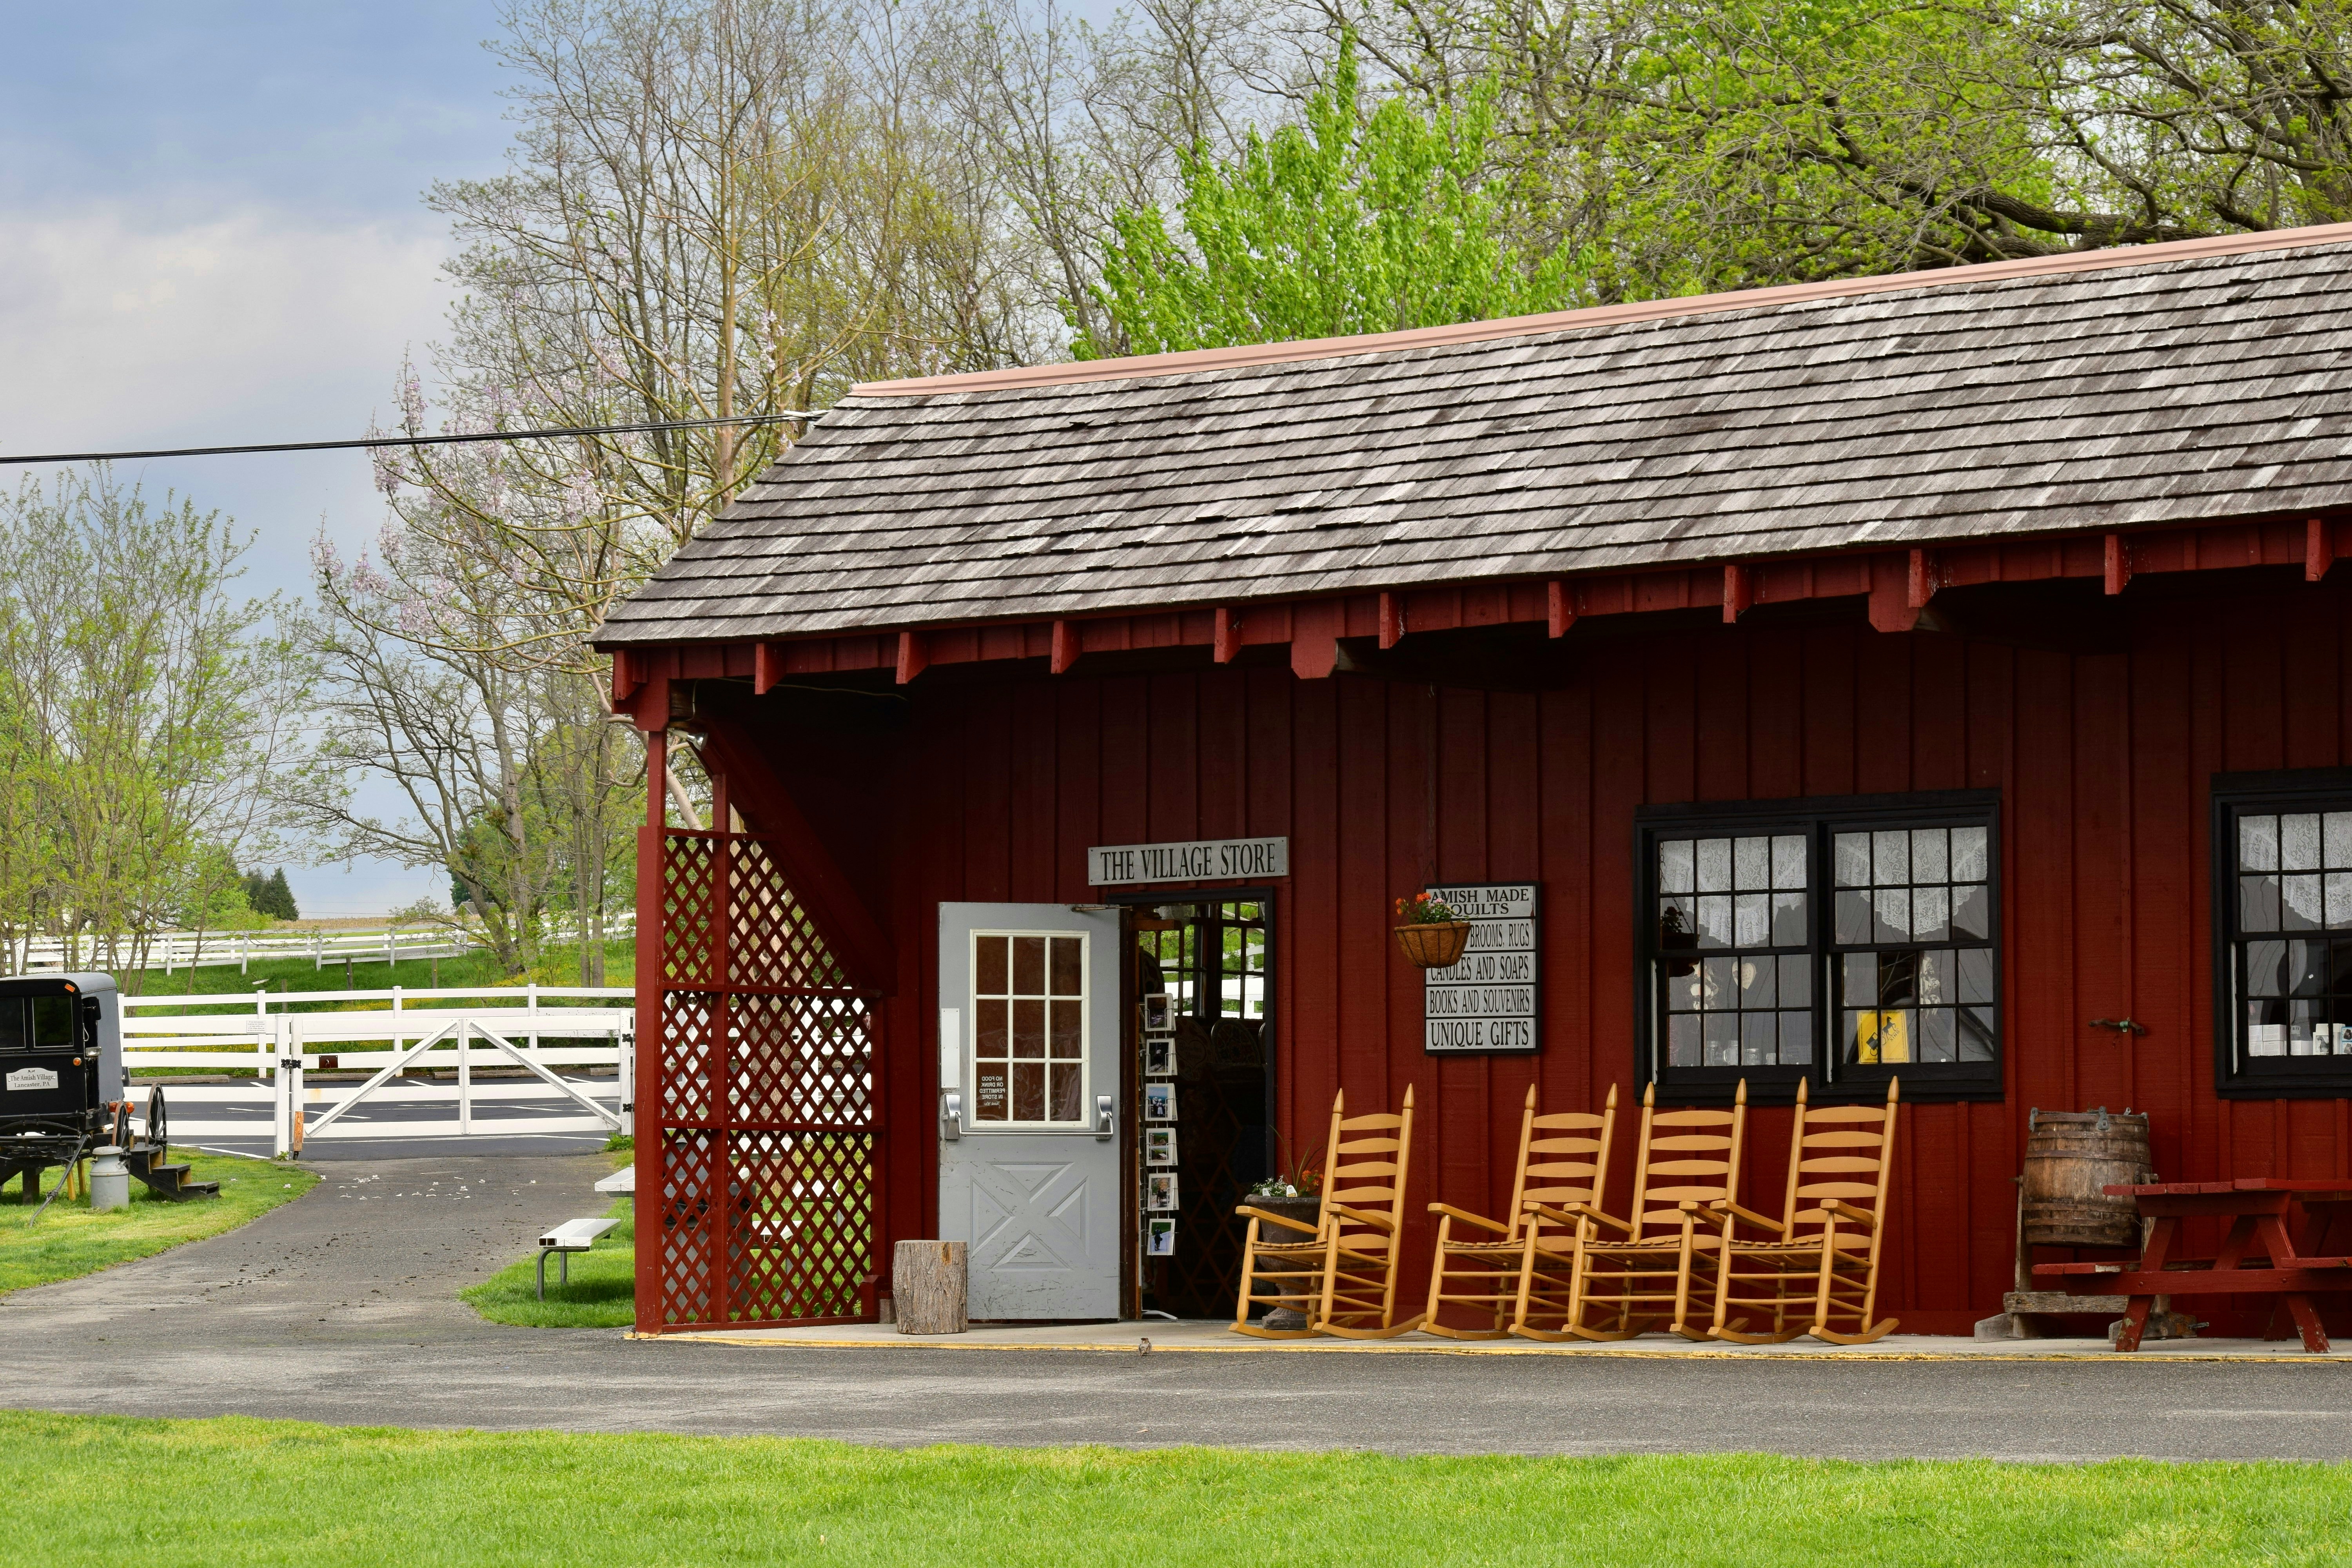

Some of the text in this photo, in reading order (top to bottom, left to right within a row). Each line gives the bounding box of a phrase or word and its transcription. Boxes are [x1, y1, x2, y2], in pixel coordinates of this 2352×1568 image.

[1100, 843, 1276, 881] THE VILLAGE STORE
[1430, 889, 1529, 904] AMISH MADE
[1451, 903, 1509, 917] QUILTS
[1470, 923, 1529, 948] BROOMS, RUGS
[1475, 956, 1495, 980] AND
[1500, 955, 1529, 980] SOAPS
[1430, 988, 1530, 1014] BOOKS AND SOUVENIRS
[1430, 1021, 1529, 1047] UNIQUE GIFTS
